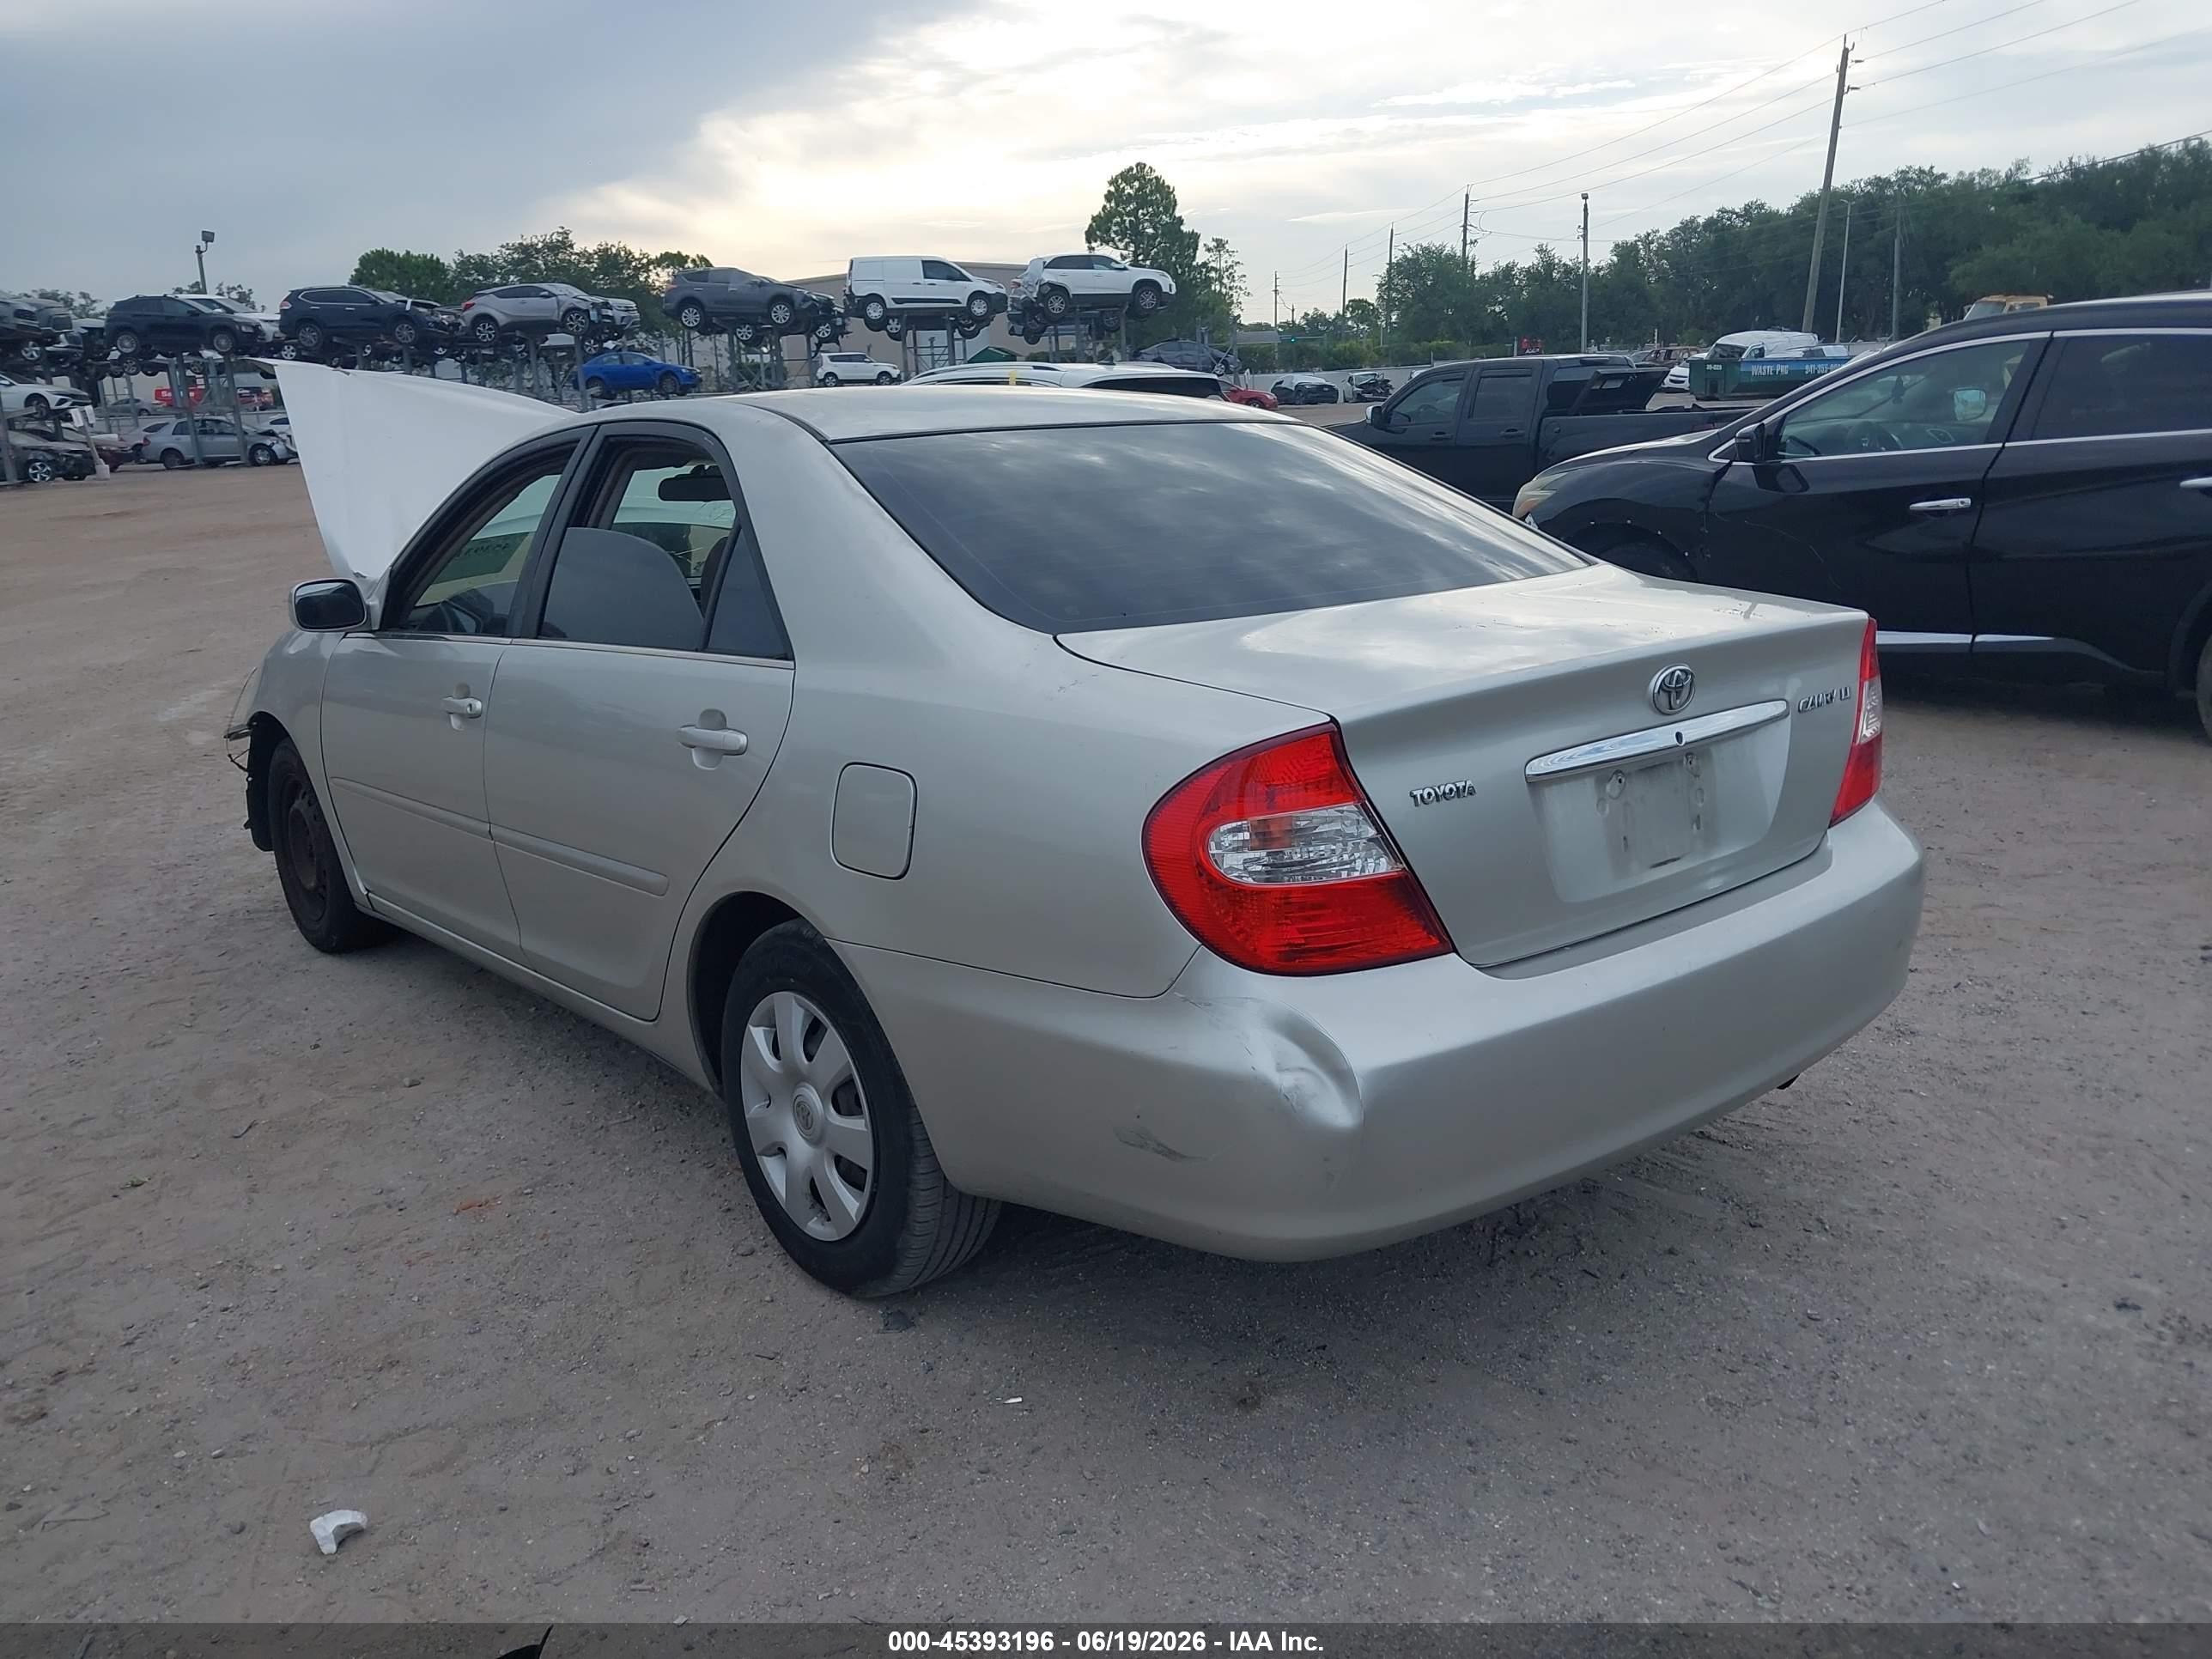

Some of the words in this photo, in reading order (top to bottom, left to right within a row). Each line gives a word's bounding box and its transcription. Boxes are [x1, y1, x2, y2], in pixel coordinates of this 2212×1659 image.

[1752, 364, 1773, 375] WASTE
[1805, 363, 1844, 374] 941-355-
[1409, 779, 1477, 807] TOYOTA
